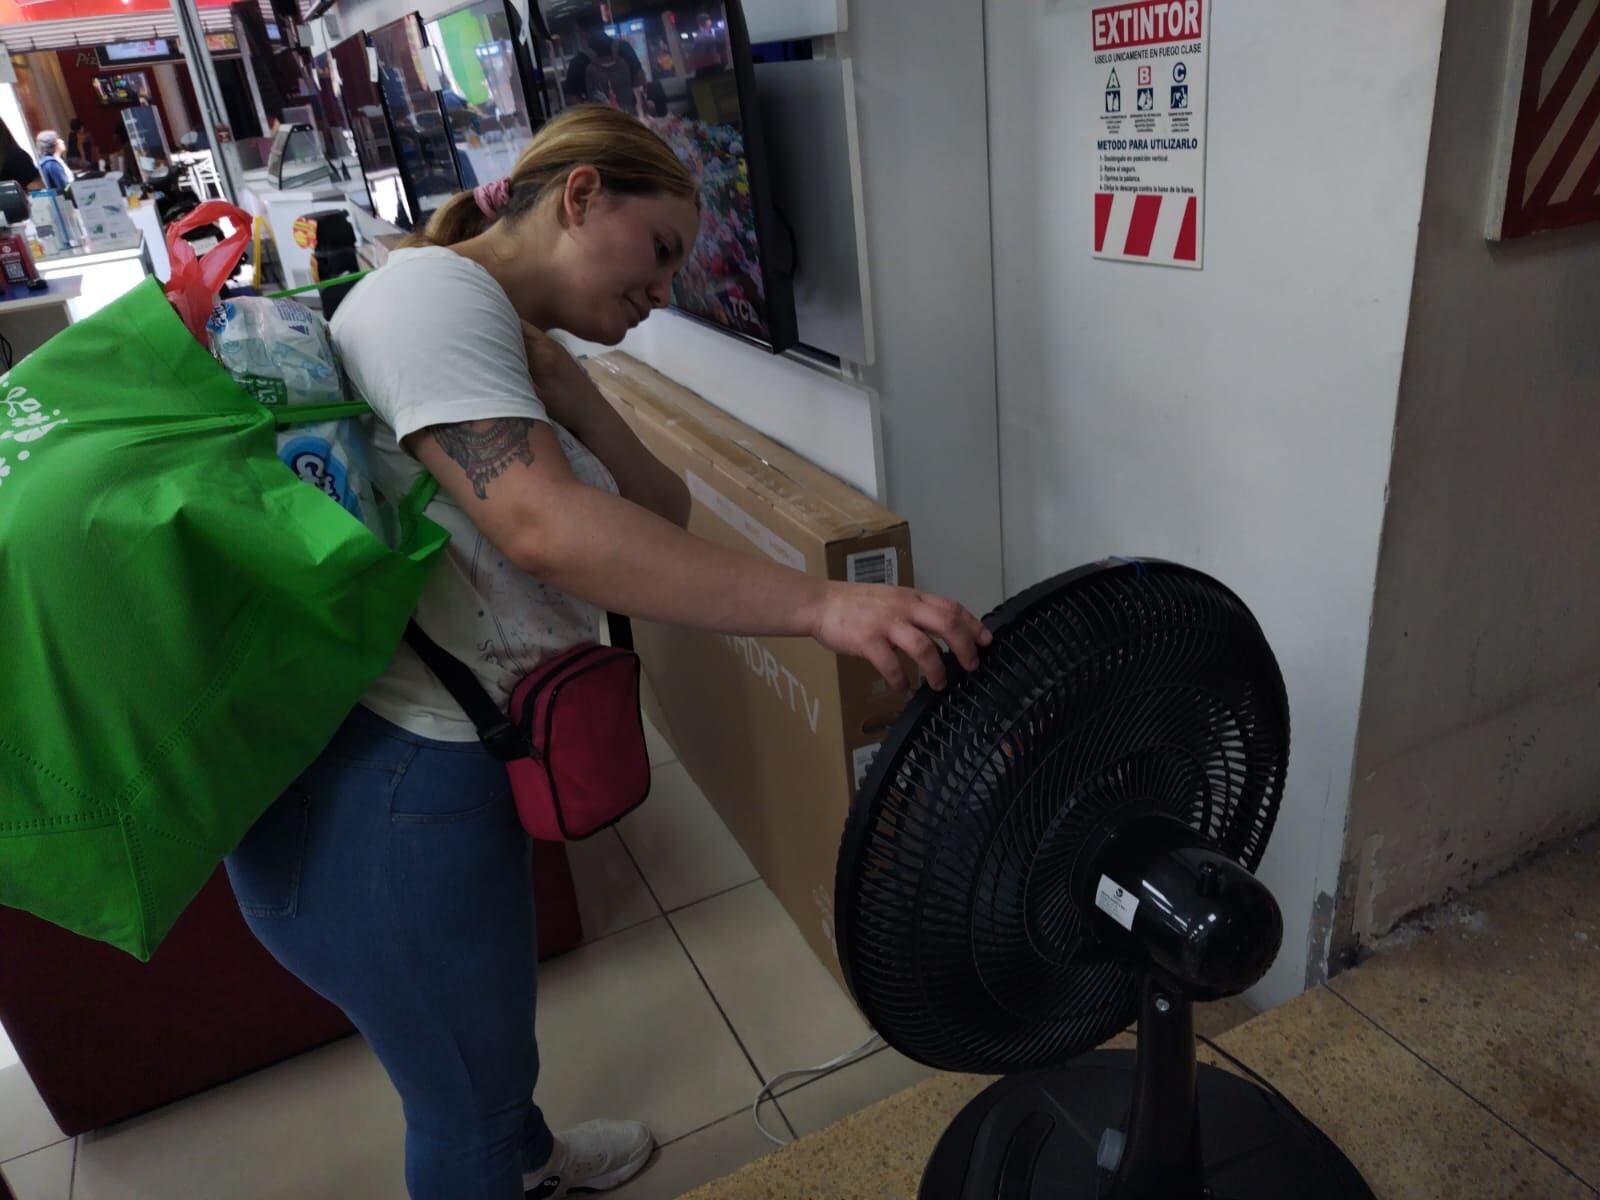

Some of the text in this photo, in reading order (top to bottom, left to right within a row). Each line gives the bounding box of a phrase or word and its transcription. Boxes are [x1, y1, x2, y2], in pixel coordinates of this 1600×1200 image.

[1094, 0, 1199, 46] EXTINTOR
[1095, 43, 1201, 64] USELO UNICAMENTE EN FUEGO CLASE
[1139, 66, 1151, 85] B
[1097, 138, 1198, 150] METODO PARA UTILIZARLO
[728, 296, 763, 328] TCL
